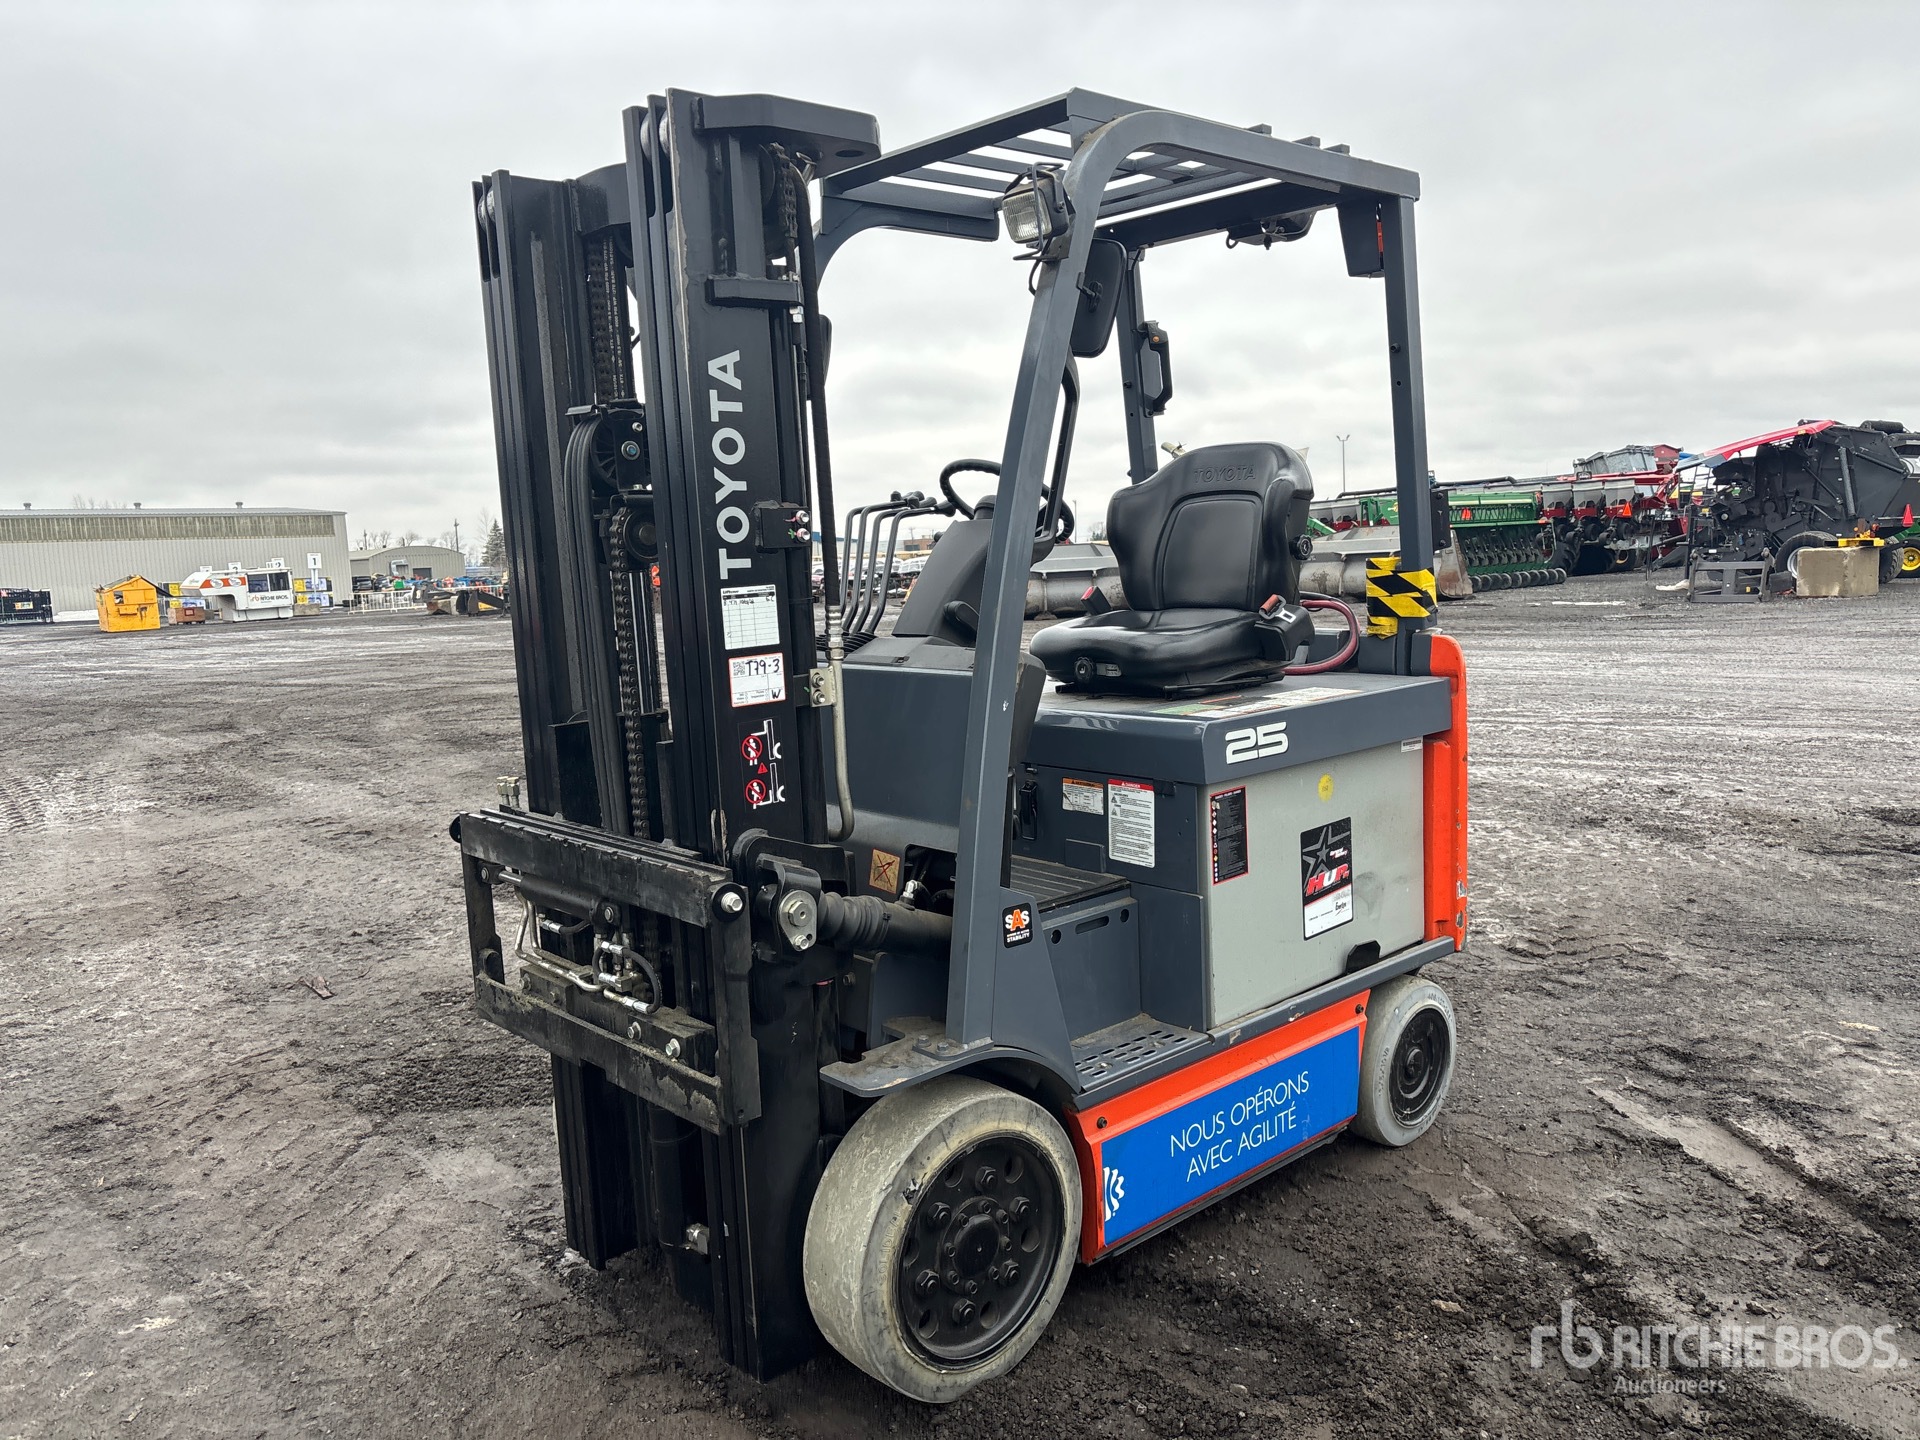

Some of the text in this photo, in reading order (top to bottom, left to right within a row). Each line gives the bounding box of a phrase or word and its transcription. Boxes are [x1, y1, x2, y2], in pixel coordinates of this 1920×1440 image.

[707, 349, 752, 580] TOYOTA
[1193, 465, 1256, 484] TOYOTA
[1225, 721, 1289, 765] 25
[1005, 908, 1030, 932] SAS
[1006, 932, 1030, 943] STABILITY
[1170, 1070, 1310, 1157] NOUS OPÉRONS
[1186, 1100, 1297, 1183] AVEC AGILITÉ
